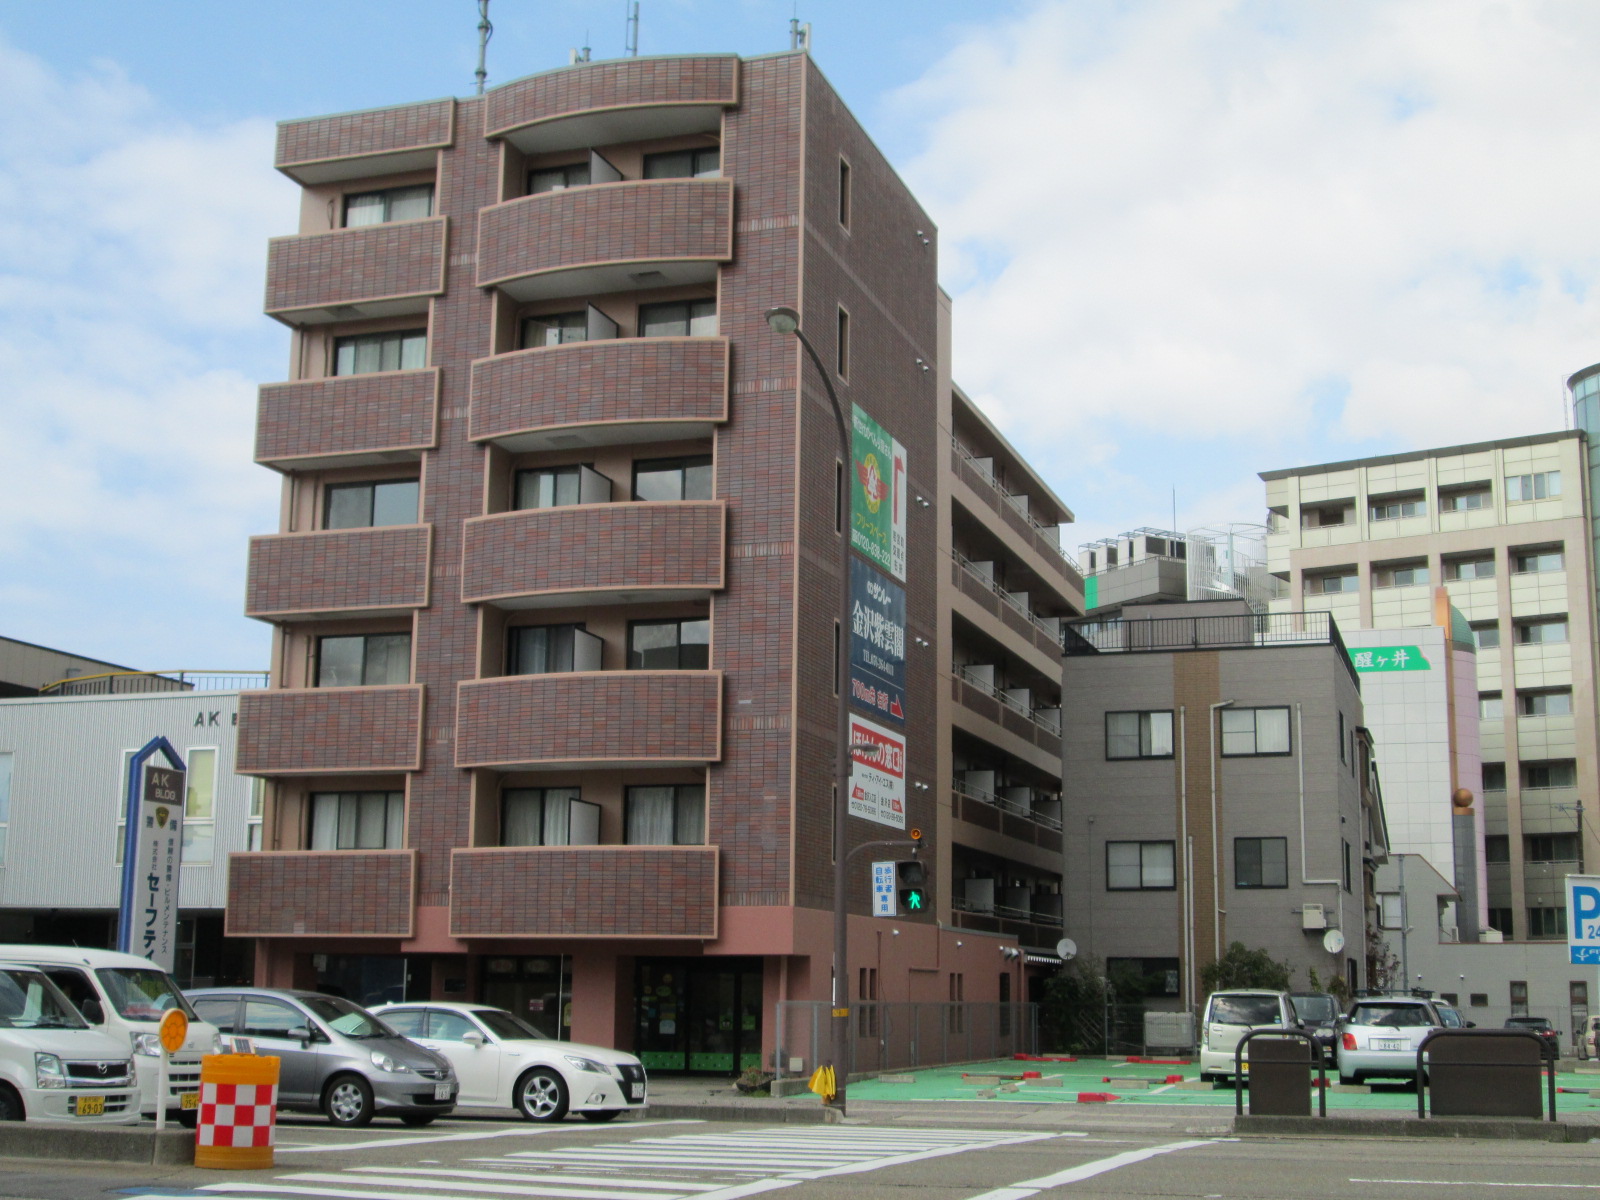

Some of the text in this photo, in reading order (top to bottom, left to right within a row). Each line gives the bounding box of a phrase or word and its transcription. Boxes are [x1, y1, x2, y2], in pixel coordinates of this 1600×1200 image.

[852, 599, 903, 661] 金沢紫雲閣
[193, 710, 220, 728] AK
[151, 772, 170, 788] AK
[1572, 885, 1600, 939] P
